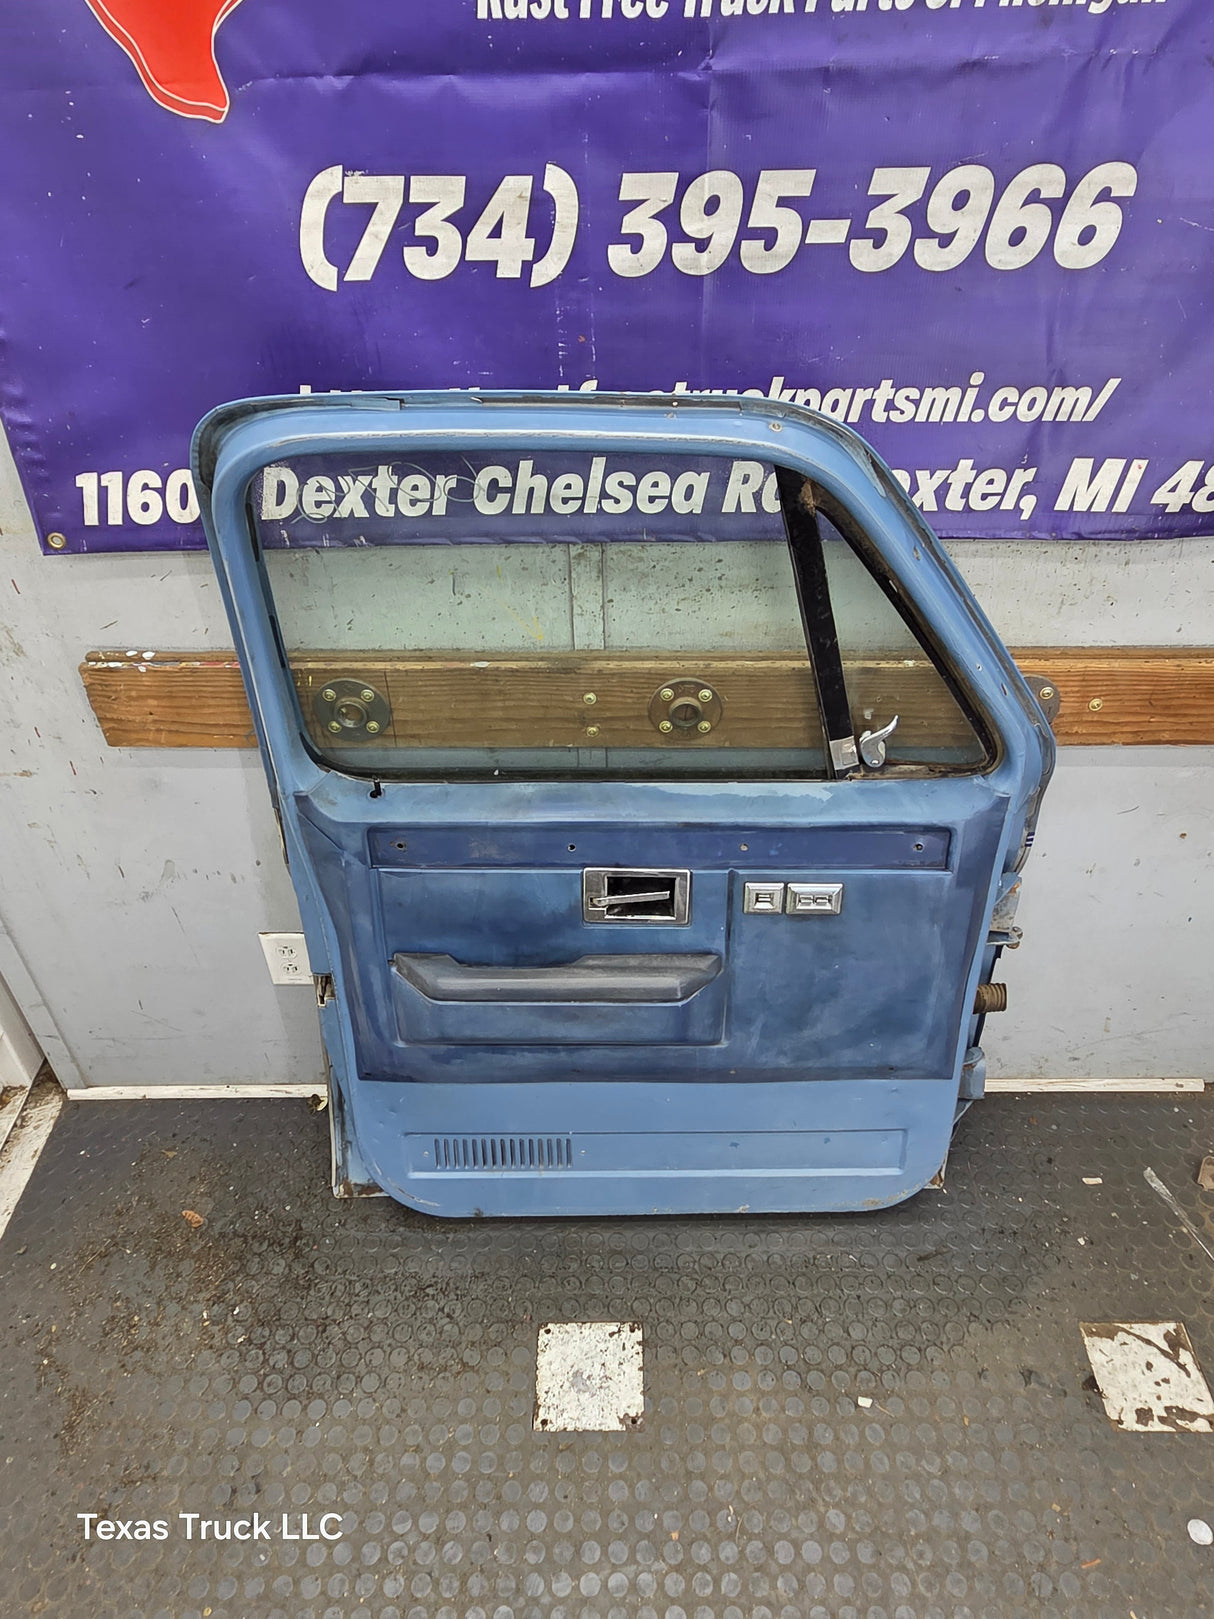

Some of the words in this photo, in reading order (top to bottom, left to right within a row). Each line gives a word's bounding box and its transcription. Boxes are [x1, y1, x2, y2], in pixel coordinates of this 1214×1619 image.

[300, 164, 578, 292] (734)
[607, 161, 1137, 278] 395-3966
[261, 465, 457, 521] Dexter
[473, 456, 710, 516] Chelsea
[1053, 457, 1149, 513] MI
